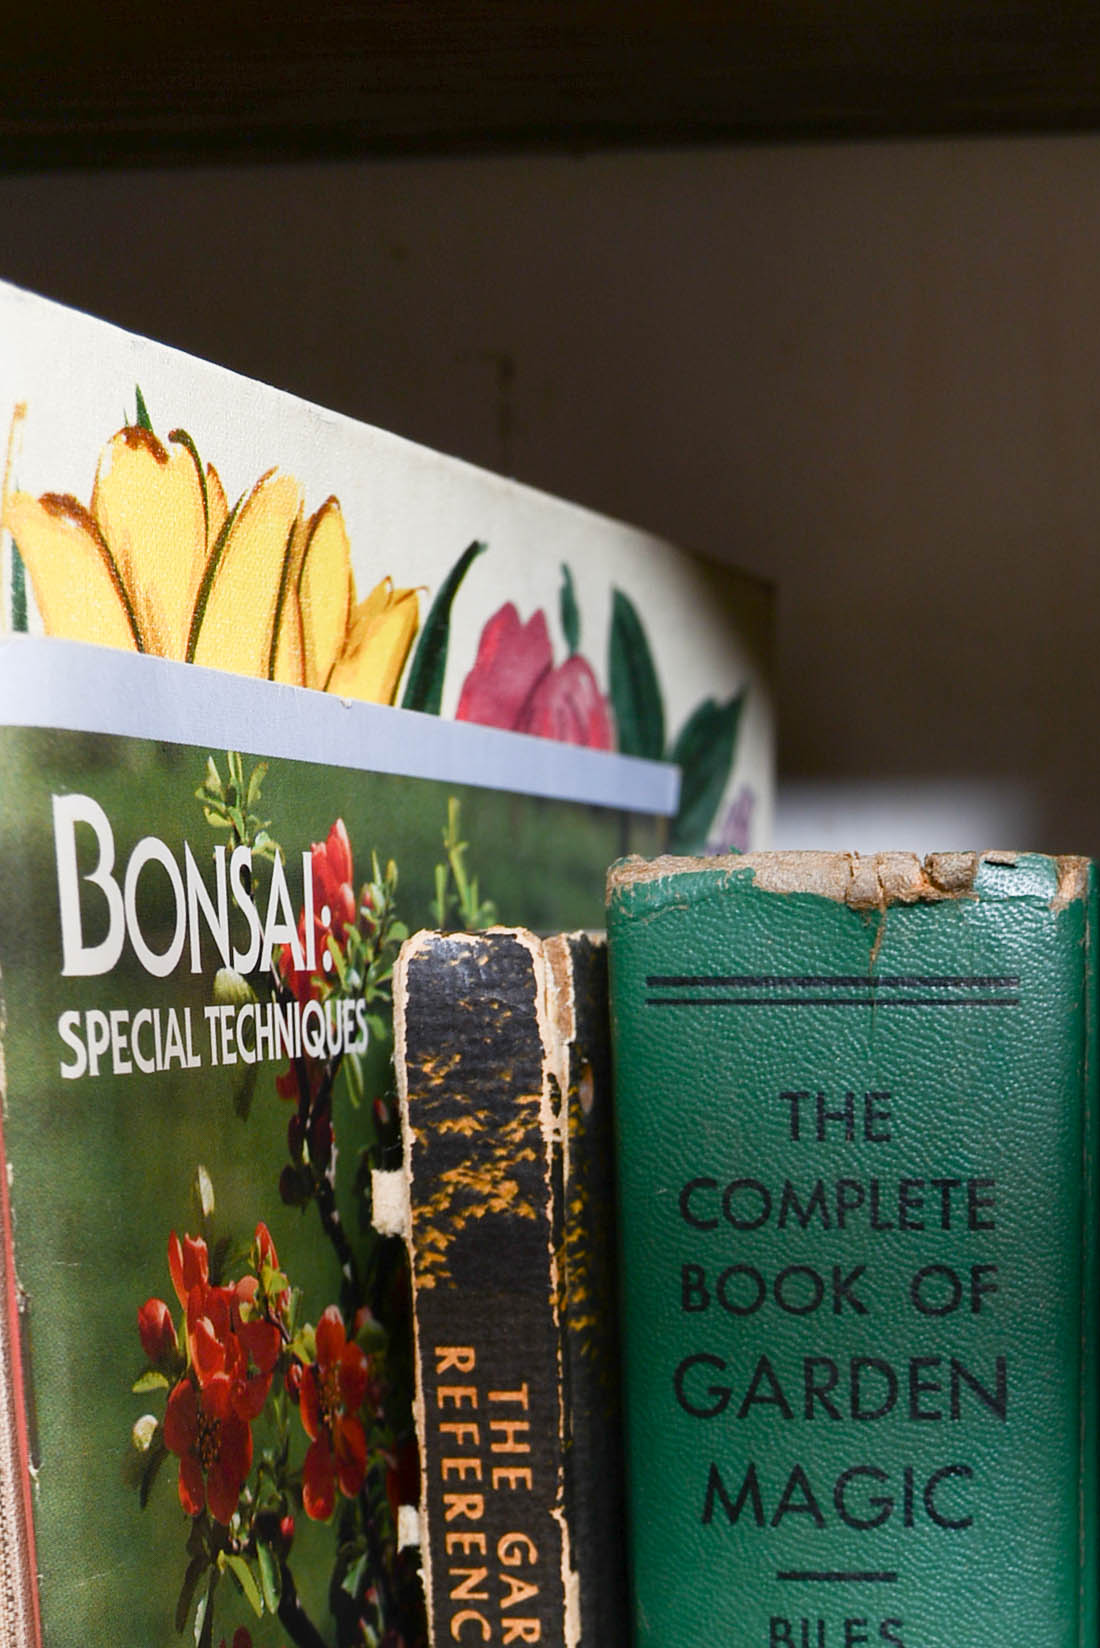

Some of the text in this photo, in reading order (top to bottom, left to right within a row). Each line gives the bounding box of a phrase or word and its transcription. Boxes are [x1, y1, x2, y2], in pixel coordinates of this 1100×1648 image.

[51, 793, 333, 977] BONSAI:
[57, 998, 369, 1078] SPECIAL TECHNIQUES
[779, 1091, 893, 1143] THE
[678, 1177, 999, 1232] COMPLETE
[680, 1264, 999, 1317] BOOK OF
[672, 1353, 1010, 1424] GARDEN
[487, 1382, 533, 1493] THE
[700, 1462, 976, 1531] MAGIC
